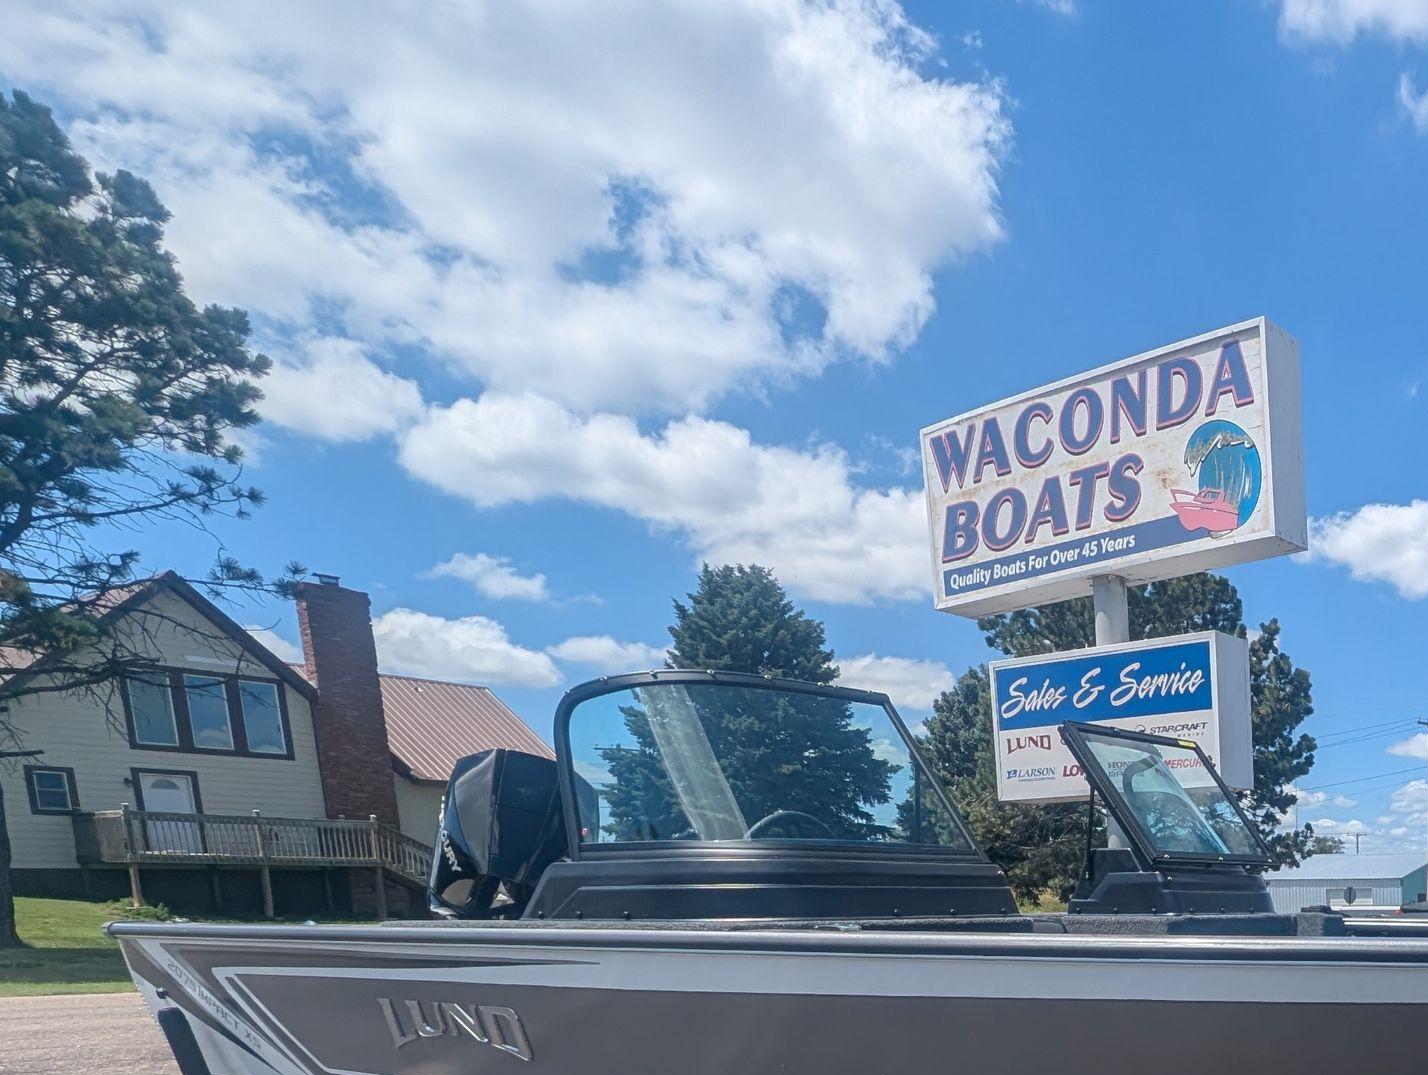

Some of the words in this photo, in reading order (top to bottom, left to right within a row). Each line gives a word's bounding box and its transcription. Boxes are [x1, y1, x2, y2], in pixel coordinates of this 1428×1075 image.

[930, 338, 1255, 494] WACONDA
[942, 452, 1144, 563] BOATS
[950, 568, 991, 590] Quality
[993, 561, 1026, 579] Boats
[1028, 555, 1049, 571] For
[1050, 548, 1080, 566] Over
[1081, 542, 1098, 558] 45
[1100, 534, 1136, 553] Years
[1001, 677, 1067, 719] Sales
[1073, 667, 1105, 709] &
[1110, 661, 1205, 707] Service
[1006, 735, 1052, 755] LUND
[1149, 722, 1208, 735] STARCRAFT
[1018, 766, 1056, 778] LARSON
[1063, 764, 1085, 778] LO
[1163, 758, 1202, 769] MERCUR
[376, 997, 534, 1062] LUND
